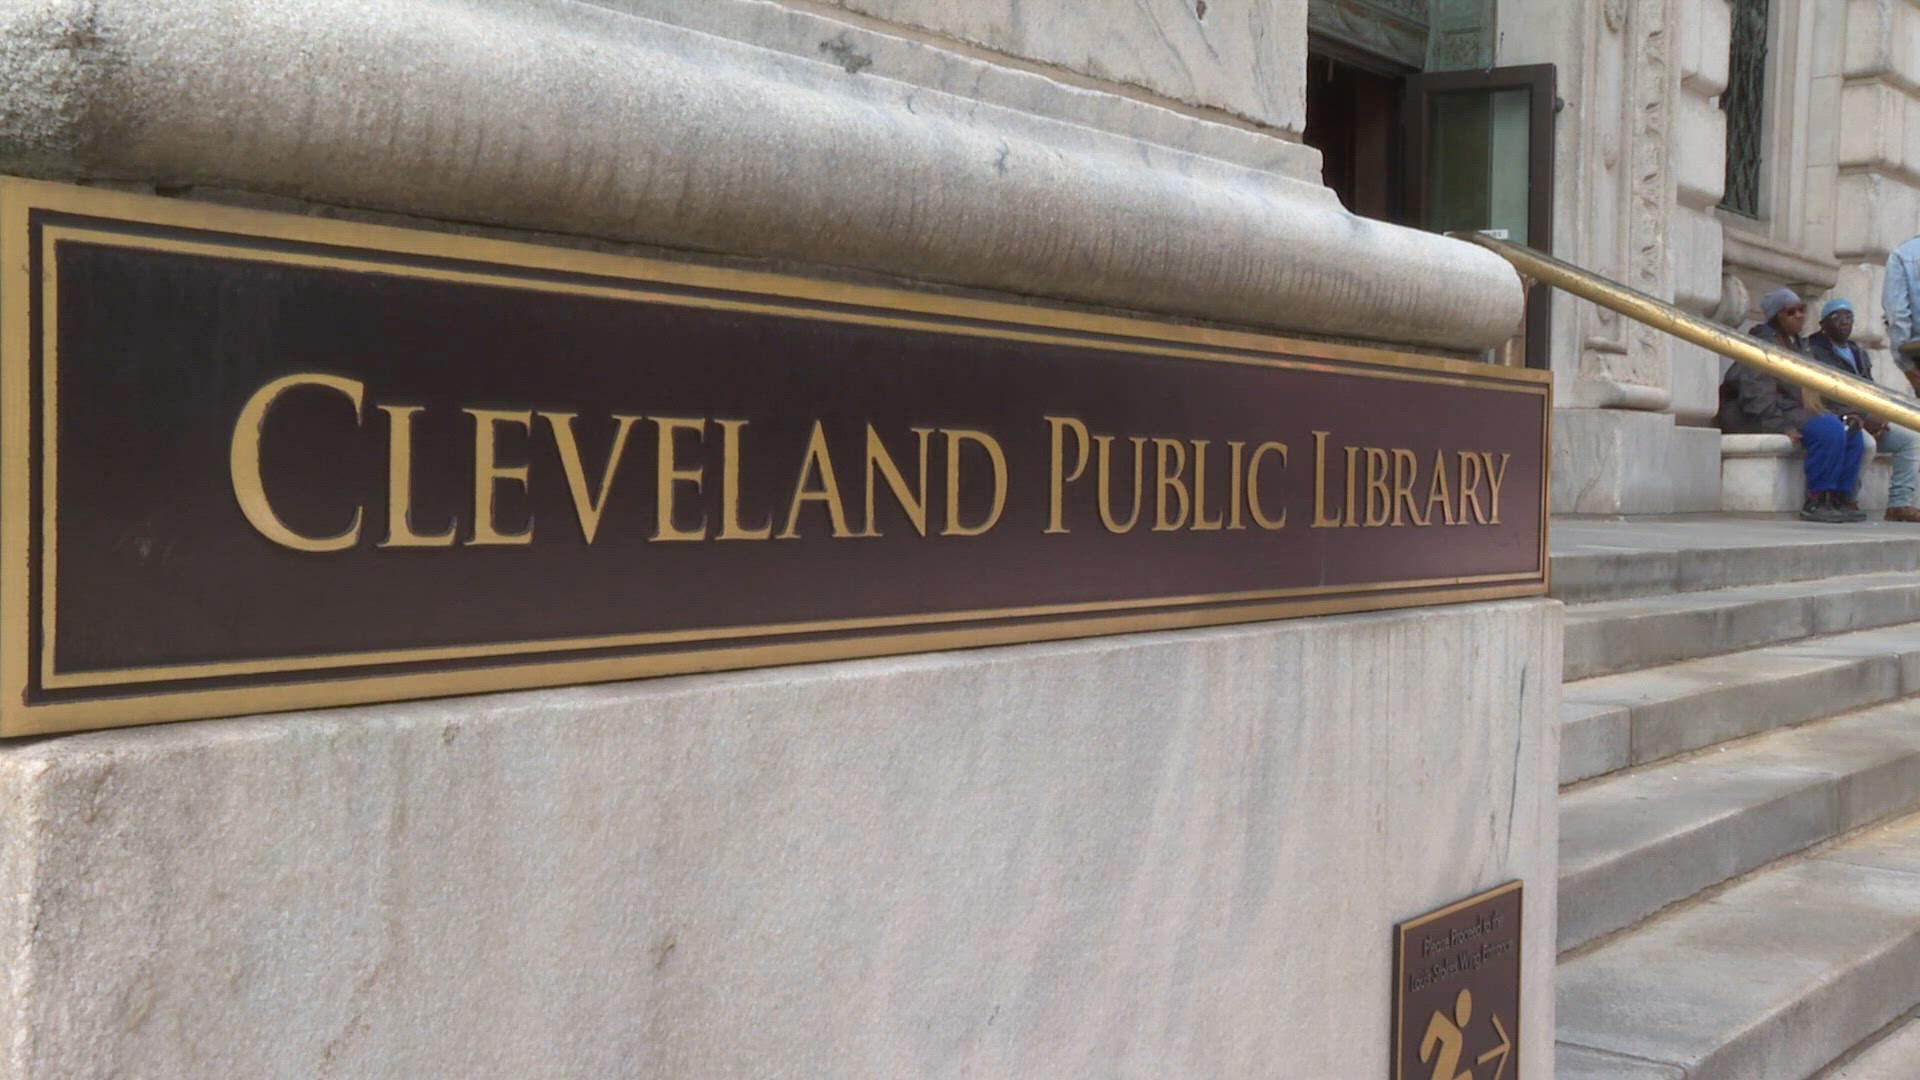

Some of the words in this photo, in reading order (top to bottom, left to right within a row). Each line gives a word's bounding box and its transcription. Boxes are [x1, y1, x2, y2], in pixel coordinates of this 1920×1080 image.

[230, 372, 1008, 552] CLEVELAND
[1043, 415, 1289, 534] PUBLIC
[1310, 430, 1511, 528] LIBRARY
